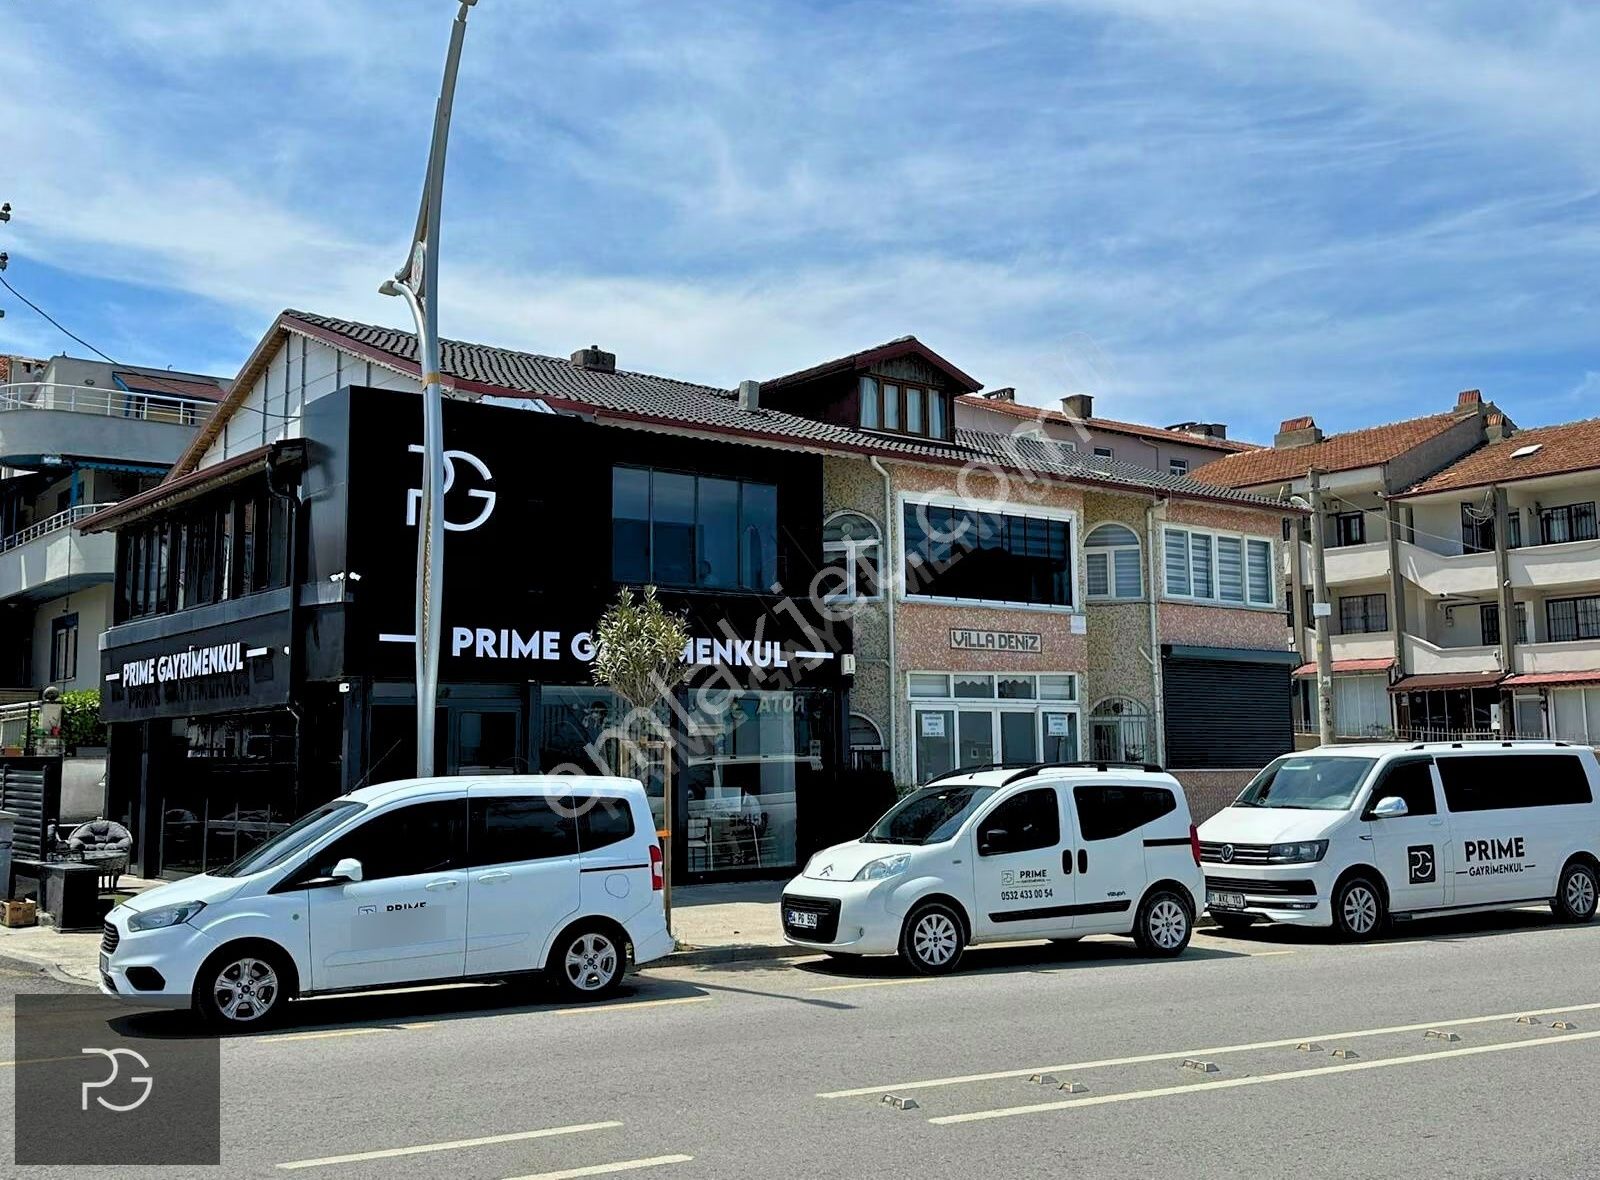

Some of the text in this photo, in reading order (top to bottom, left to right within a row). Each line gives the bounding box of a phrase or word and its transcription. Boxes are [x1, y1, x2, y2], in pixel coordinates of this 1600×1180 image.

[452, 627, 788, 668] PRIME GMENKUL
[123, 643, 243, 688] PRIME GAYRİMENKUL
[1464, 837, 1525, 862] PRIME
[1019, 869, 1047, 879] PRIME
[1001, 888, 1053, 901] 0532 433 00 54
